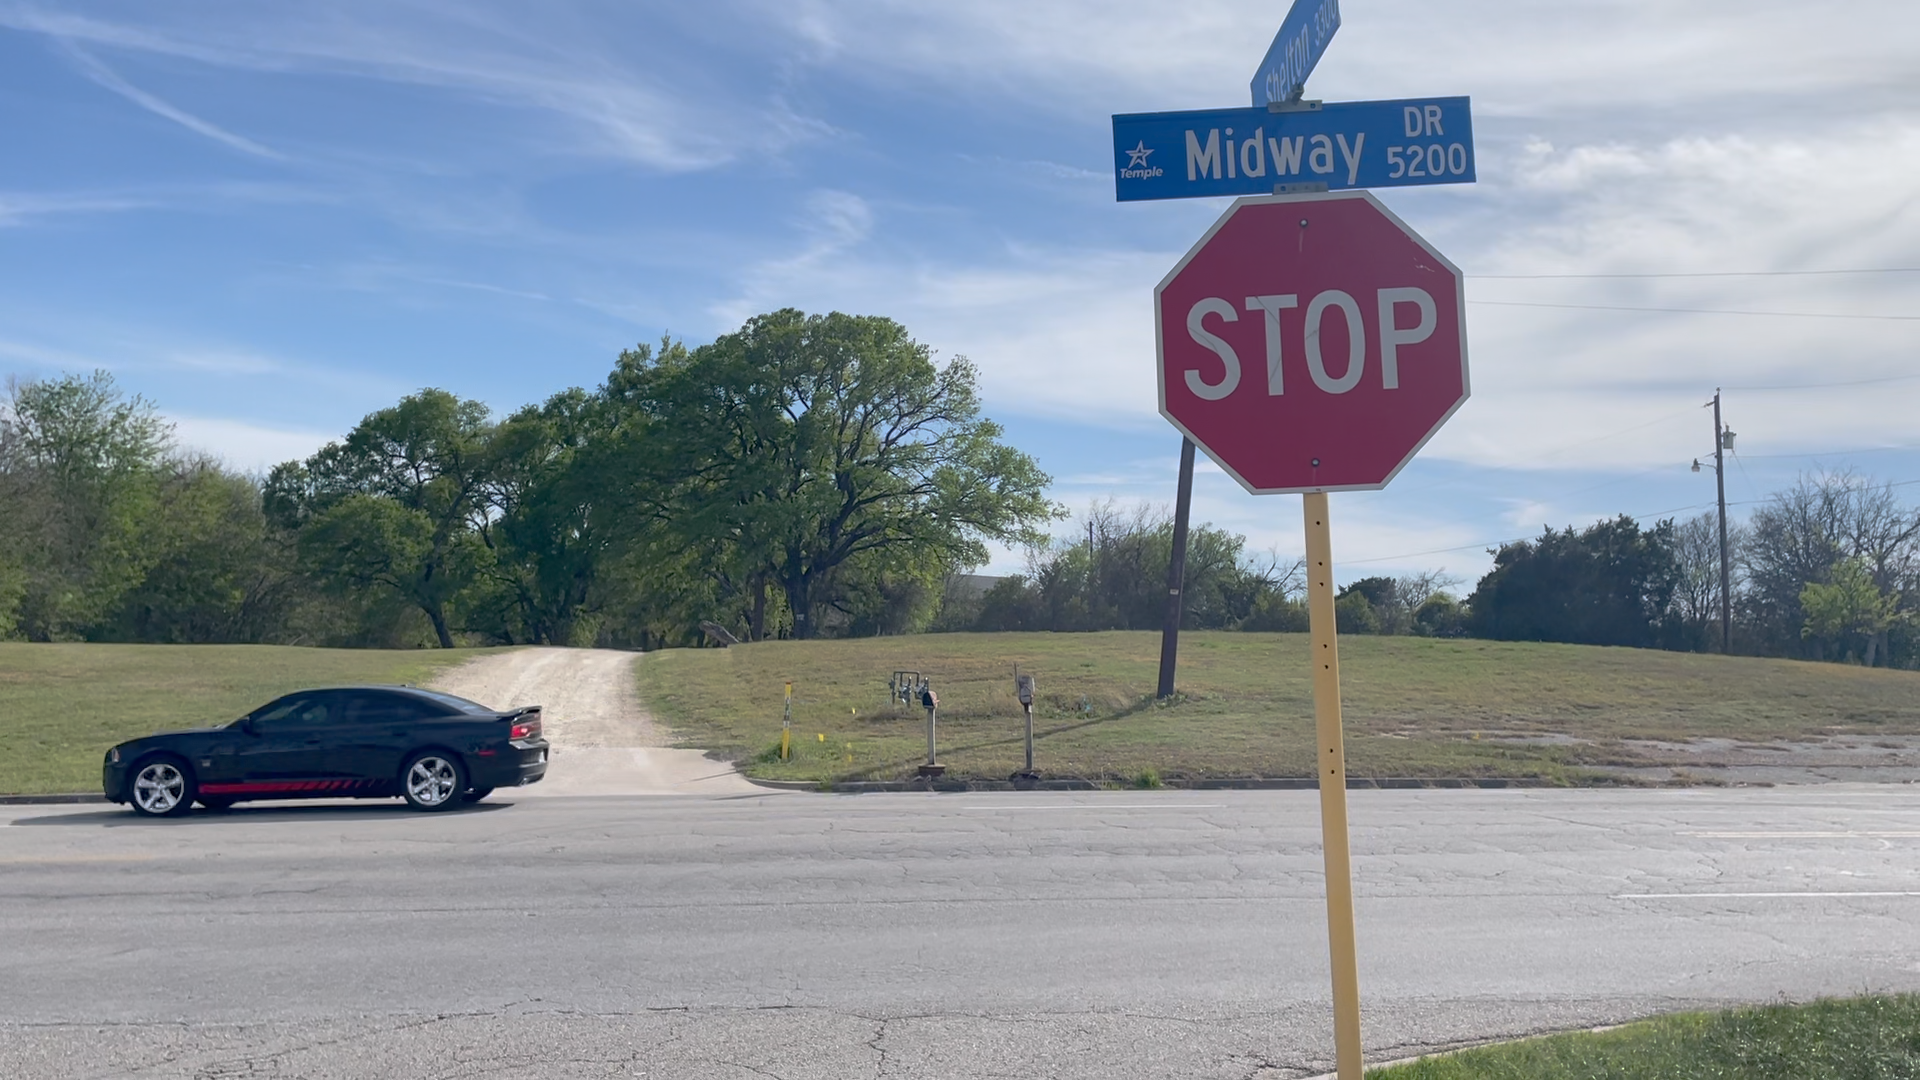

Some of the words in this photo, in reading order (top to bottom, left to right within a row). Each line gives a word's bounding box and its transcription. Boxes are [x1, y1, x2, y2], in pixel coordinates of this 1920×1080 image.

[1403, 105, 1444, 137] DR
[1120, 166, 1164, 180] Temple
[1185, 126, 1365, 185] Midway
[1387, 143, 1467, 179] 5200
[1184, 287, 1437, 401] STOP
